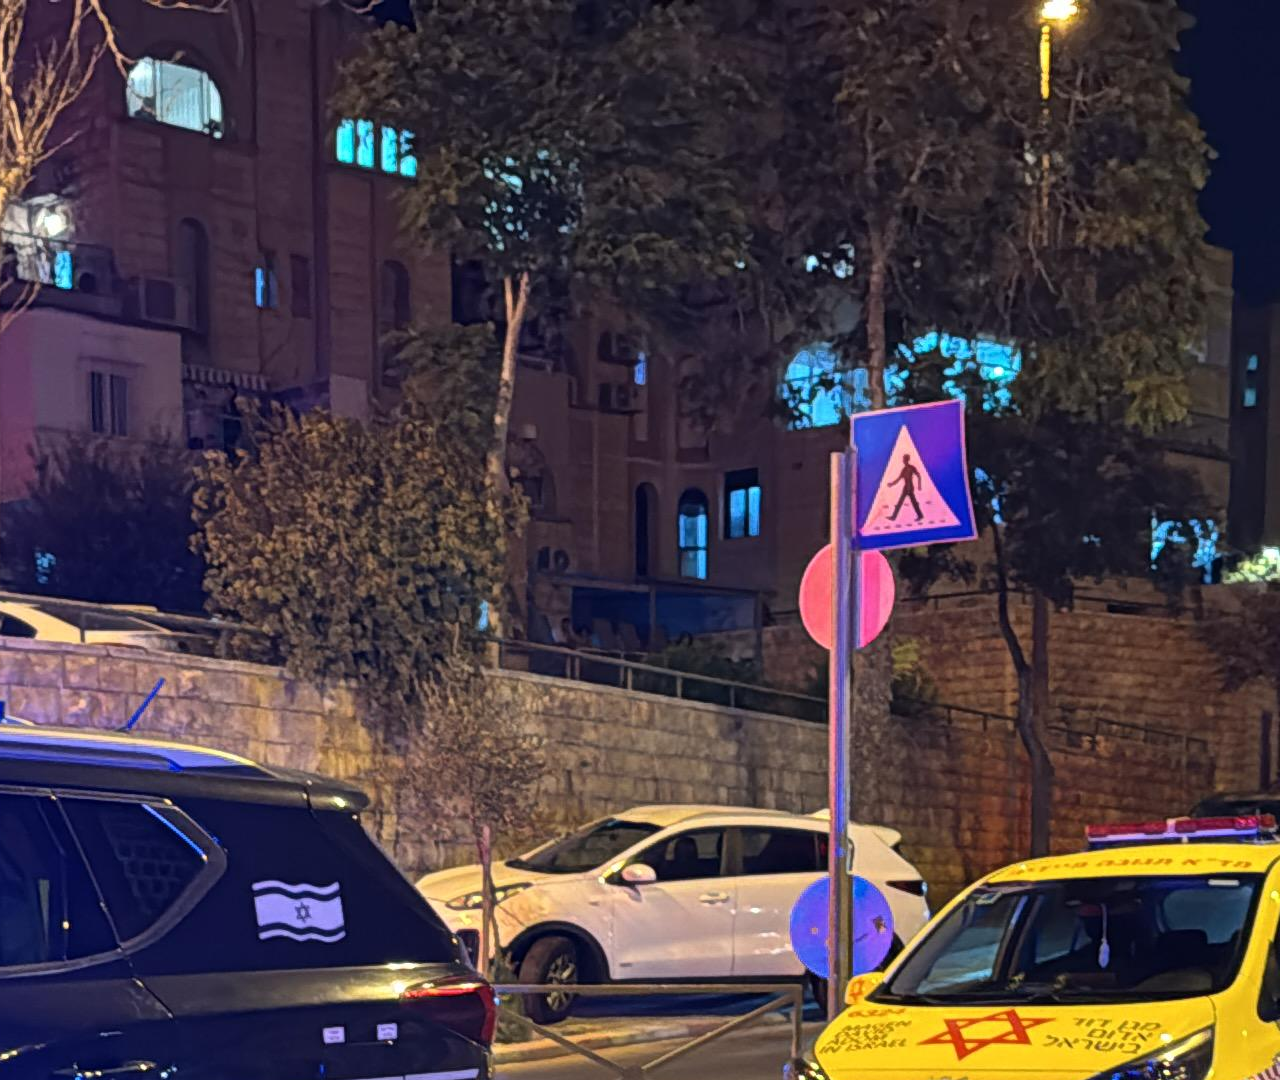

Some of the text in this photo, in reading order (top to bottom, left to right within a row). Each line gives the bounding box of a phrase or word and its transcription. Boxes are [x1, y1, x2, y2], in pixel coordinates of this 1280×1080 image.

[1073, 1018, 1162, 1033] מגן דוד
[1087, 1028, 1153, 1041] אדום
[1042, 1034, 1141, 1054] בישראל
